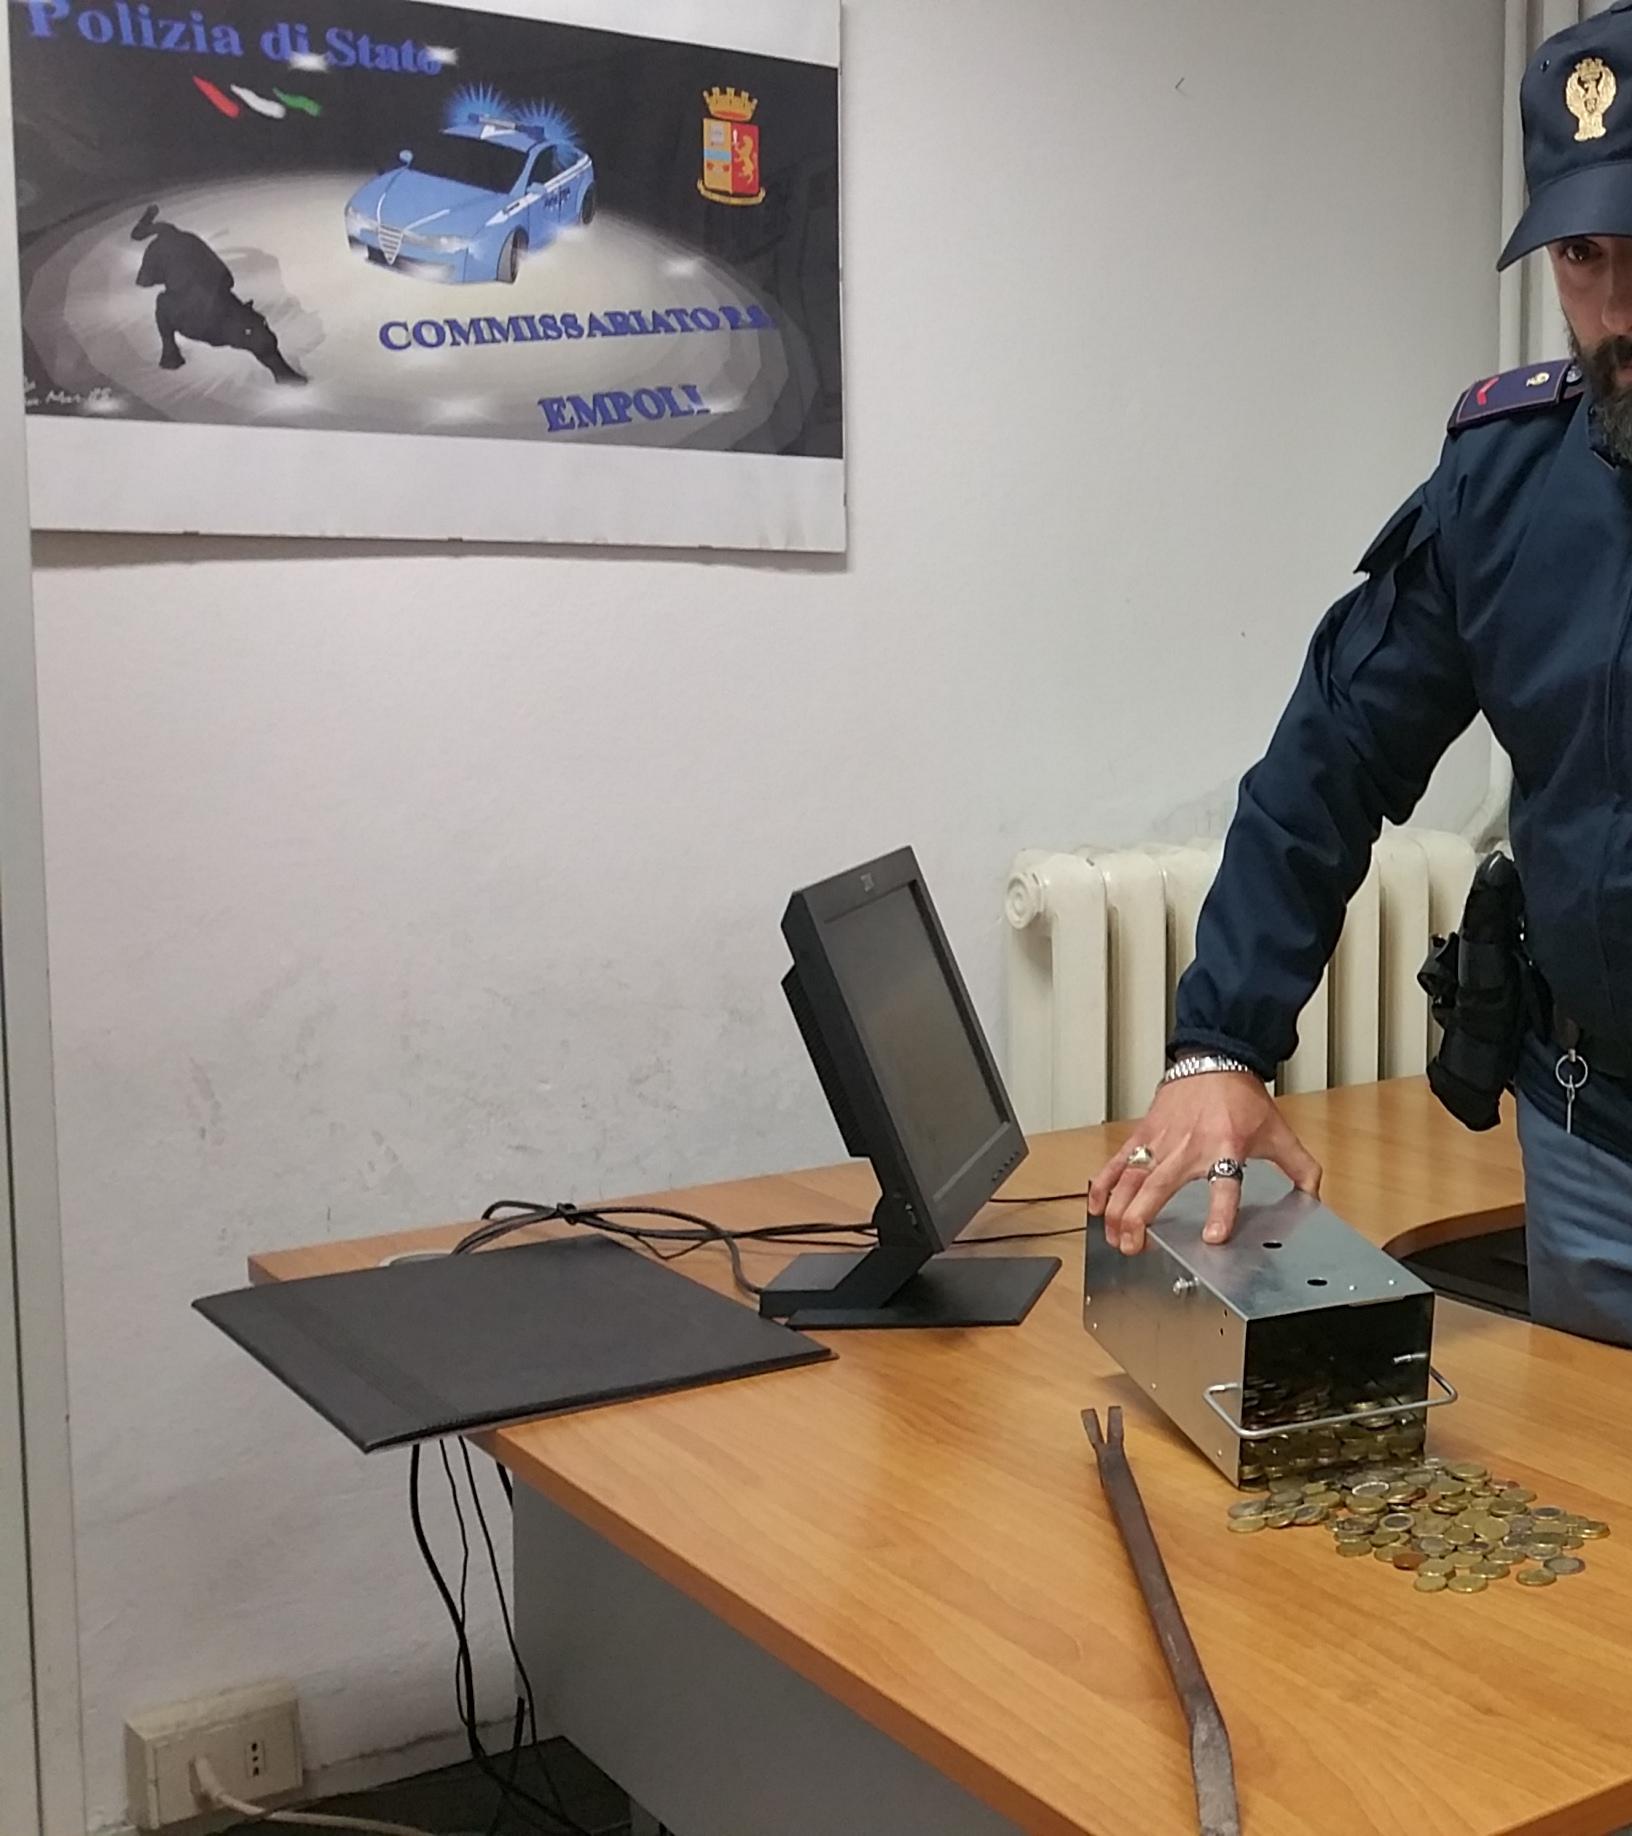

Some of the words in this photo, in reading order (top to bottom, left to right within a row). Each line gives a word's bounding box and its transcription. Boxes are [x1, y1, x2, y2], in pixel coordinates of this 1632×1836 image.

[27, 0, 243, 58] Polizia
[260, 22, 309, 62] di
[325, 26, 443, 76] Stato
[378, 306, 721, 351] COMMISSARIATO
[536, 383, 712, 432] EMPOLI
